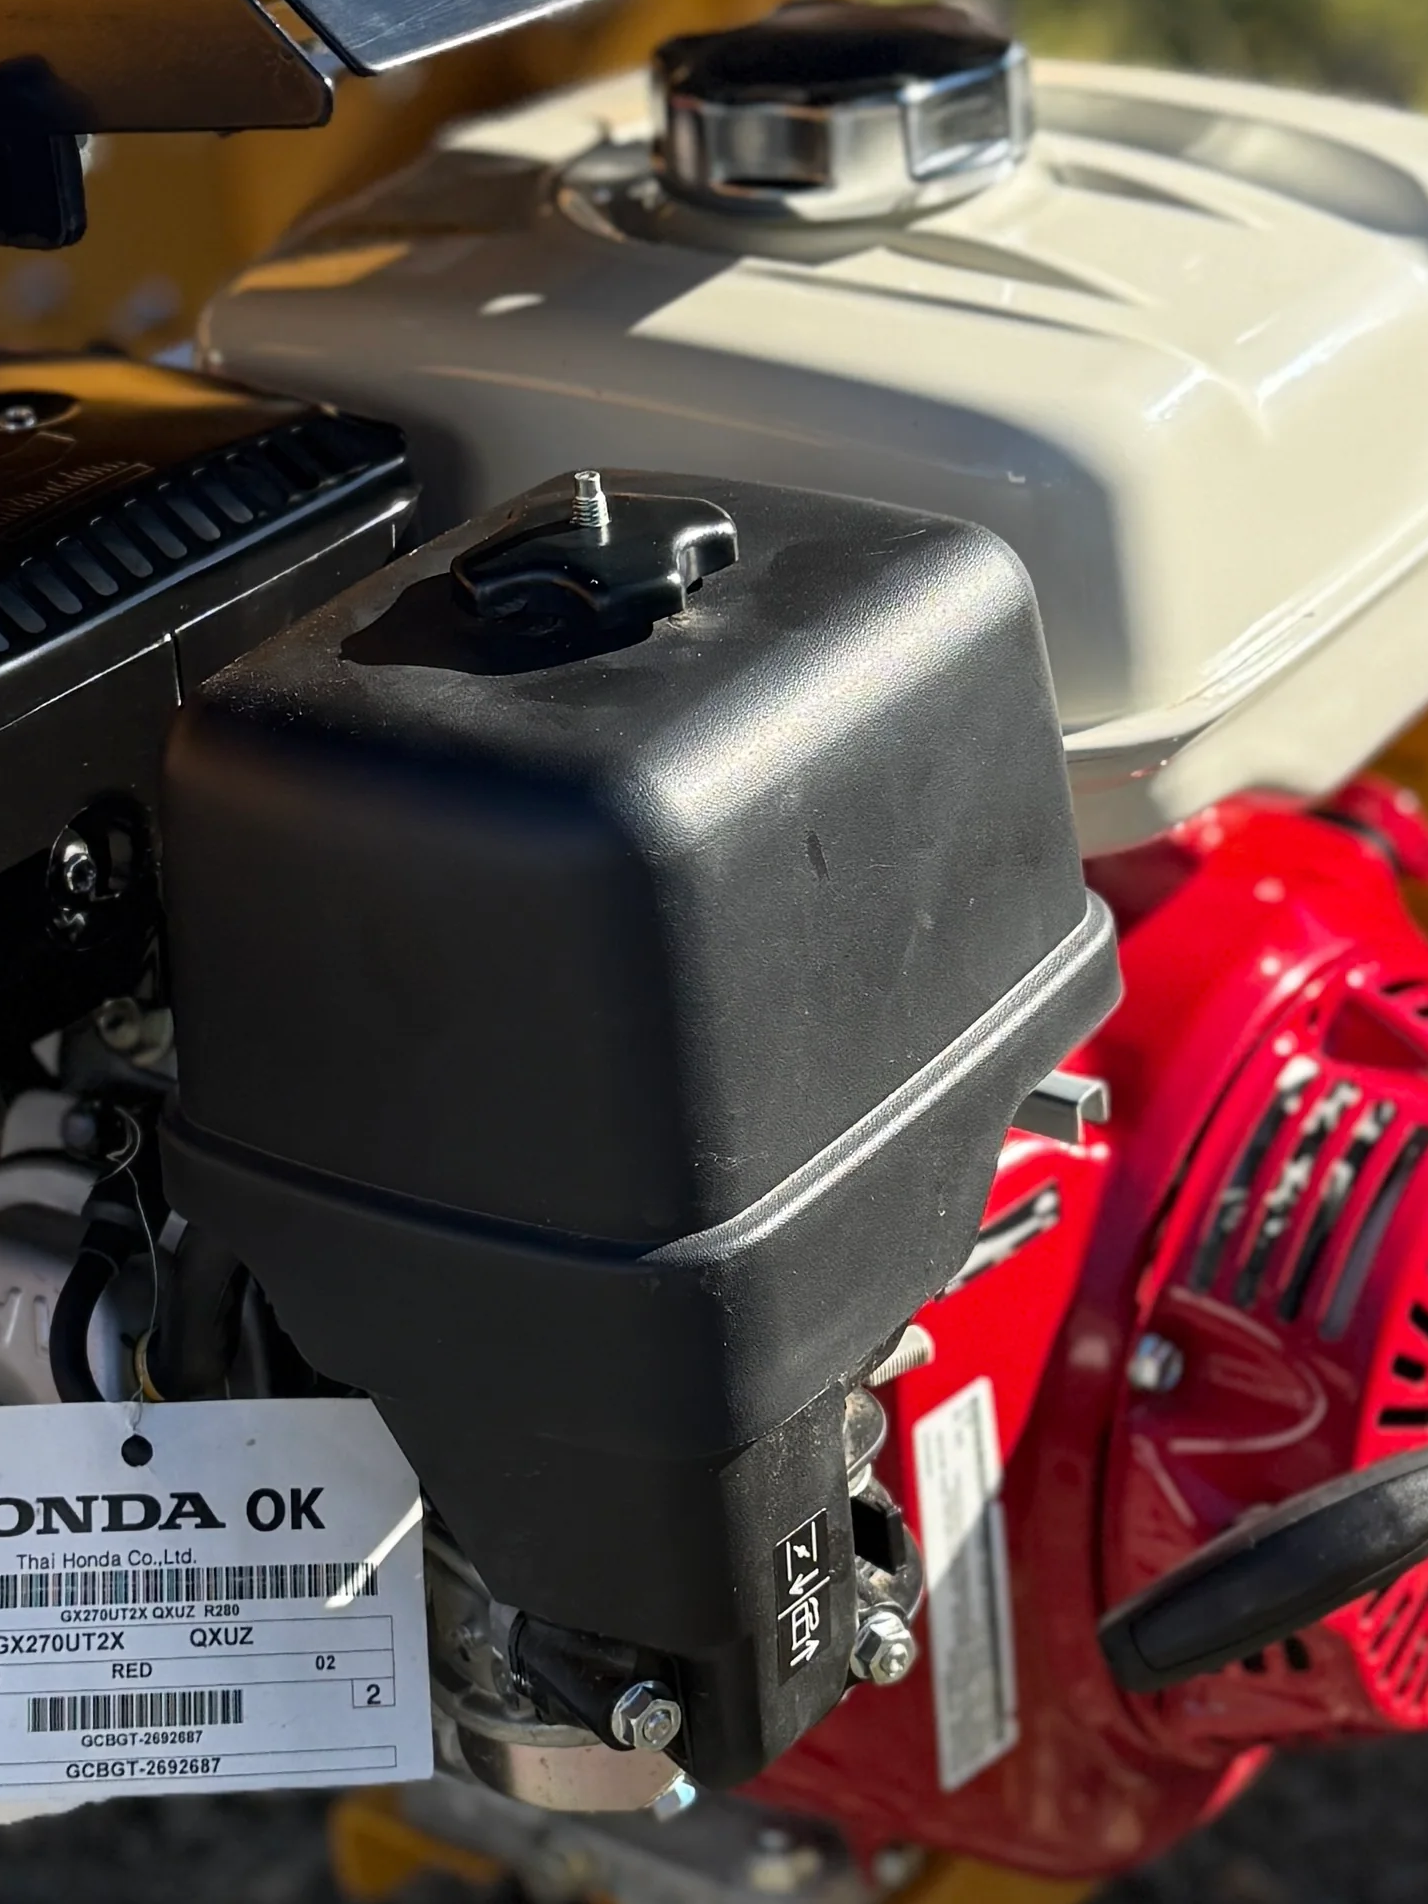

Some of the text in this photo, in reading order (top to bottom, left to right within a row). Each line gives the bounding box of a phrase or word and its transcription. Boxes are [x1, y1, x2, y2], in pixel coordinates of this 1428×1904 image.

[245, 1487, 325, 1534] OK
[17, 1548, 197, 1570] Thai Honda Co.,Ltd.
[60, 1604, 240, 1623] GX270UT2X QXUZ R280
[189, 1627, 254, 1648] QXUZ
[111, 1662, 153, 1679] RED
[315, 1655, 336, 1671] 02
[366, 1684, 382, 1706] 2
[81, 1730, 204, 1748] GCBGT-2692687
[66, 1757, 221, 1779] GCBGT-2692687
